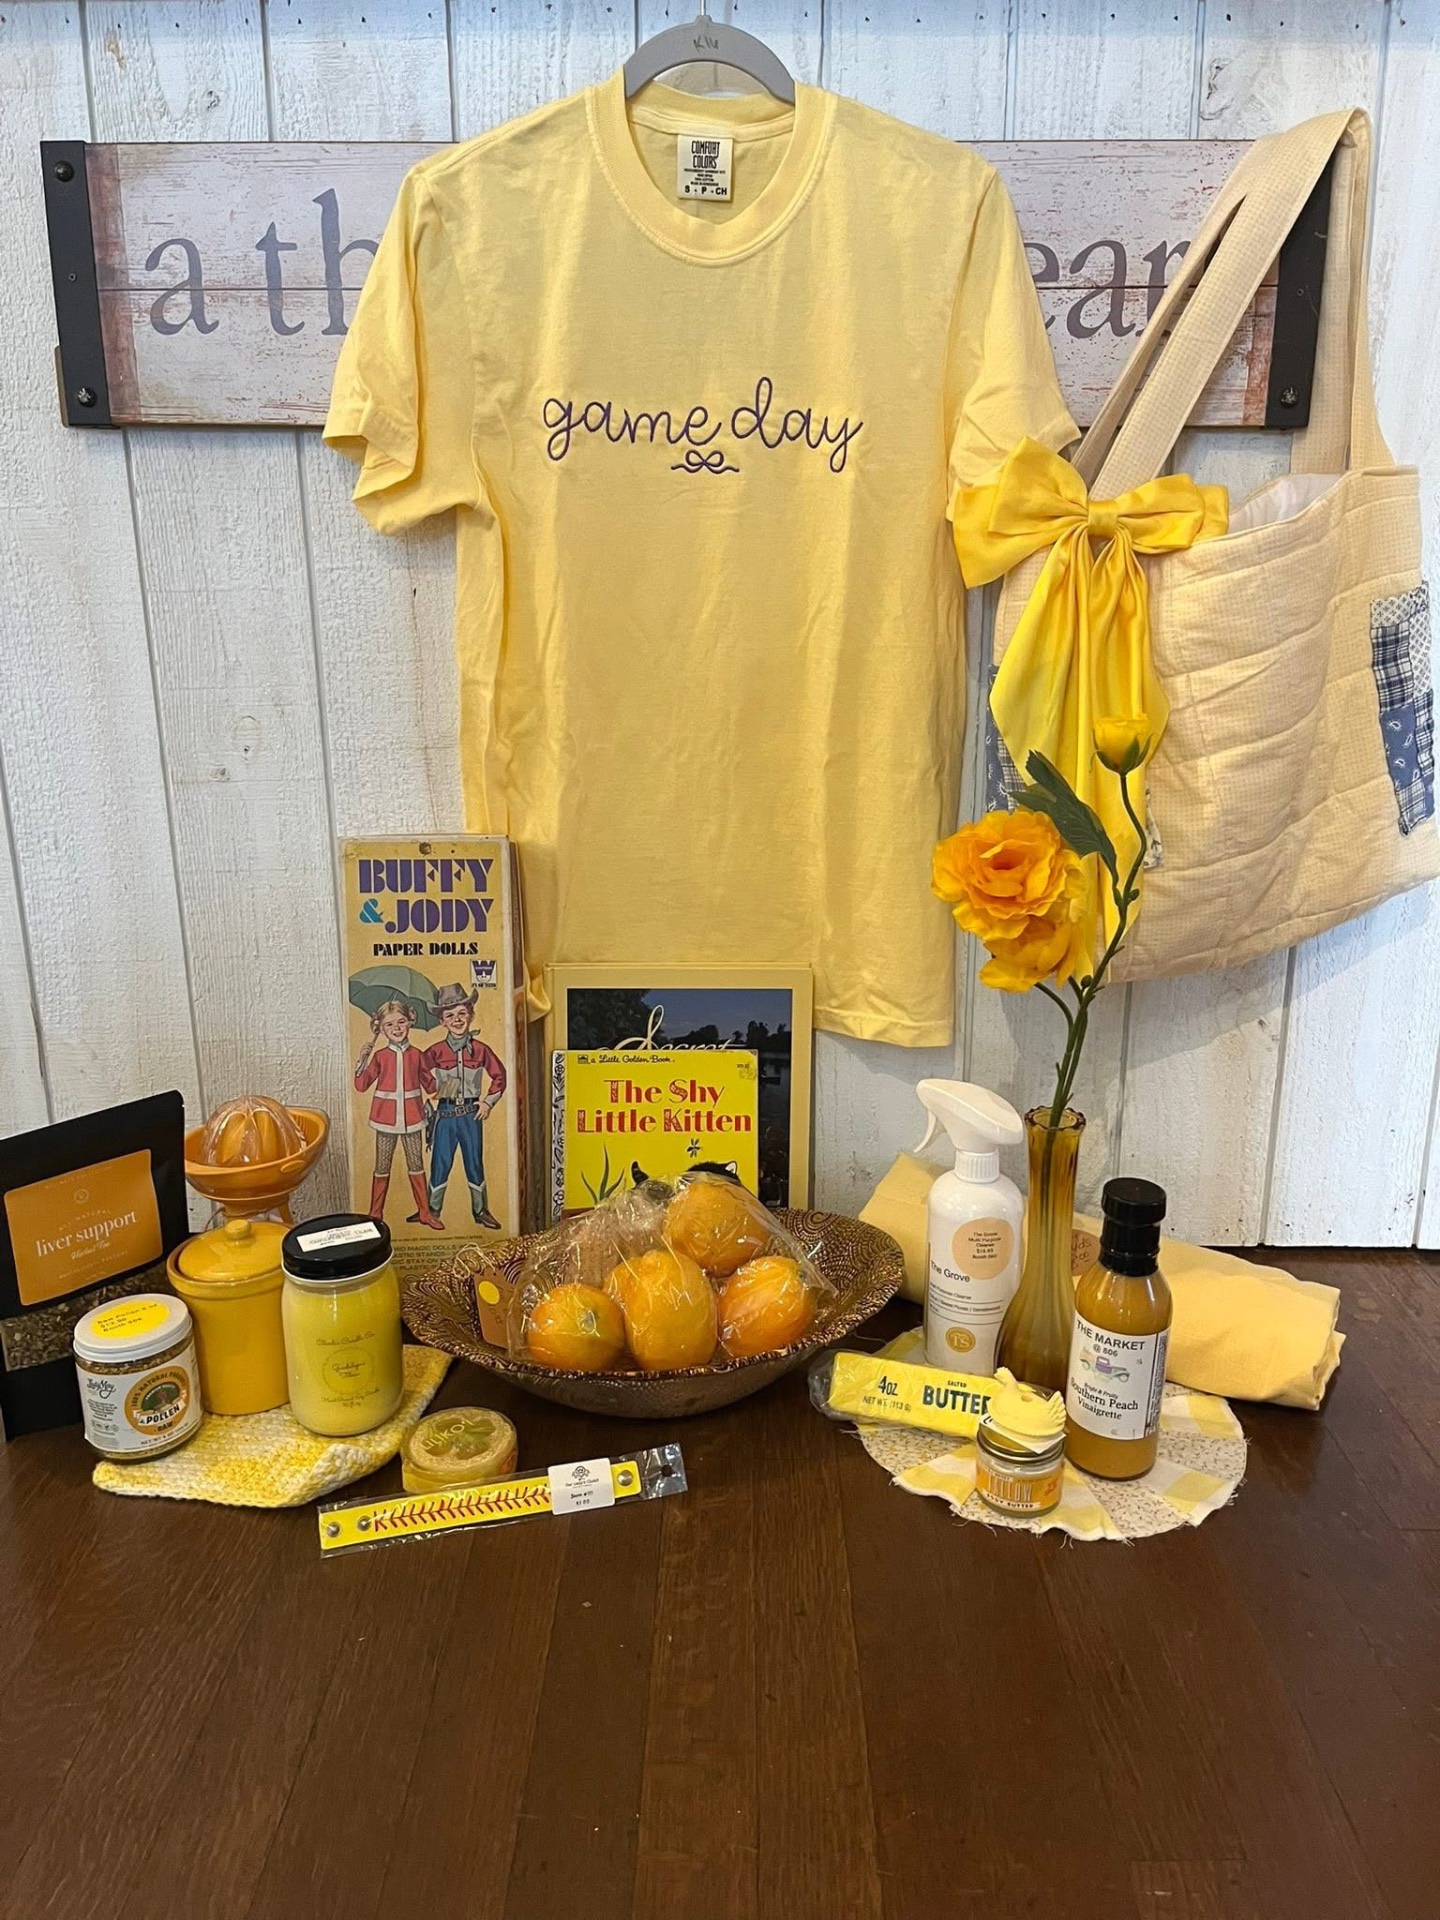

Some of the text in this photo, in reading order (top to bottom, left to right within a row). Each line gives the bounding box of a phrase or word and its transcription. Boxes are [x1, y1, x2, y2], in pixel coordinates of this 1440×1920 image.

[691, 140, 720, 159] COMFORT
[692, 155, 717, 168] COLORS
[684, 185, 690, 193] S
[145, 238, 220, 336] a
[543, 376, 864, 473] game day
[358, 858, 495, 894] BUFFY
[359, 898, 495, 934] & JODY
[373, 942, 479, 957] PAPER DOLLS
[599, 1054, 620, 1064] Little
[622, 1054, 649, 1064] Golden
[650, 1054, 671, 1064] Book
[603, 1078, 726, 1109] The Shy
[576, 1108, 752, 1134] Little Kitten
[36, 1211, 137, 1257] liver support
[930, 1260, 970, 1282] The Grove
[1076, 1319, 1146, 1350] THE MARKET
[1092, 1344, 1118, 1358] @ 806
[947, 1380, 968, 1388] SALTED
[1070, 1376, 1138, 1410] Southern Peach
[862, 1396, 876, 1404] NET
[1078, 1396, 1122, 1420] Vinaigrette
[146, 1404, 180, 1424] POLLEN
[157, 1420, 173, 1432] RAW
